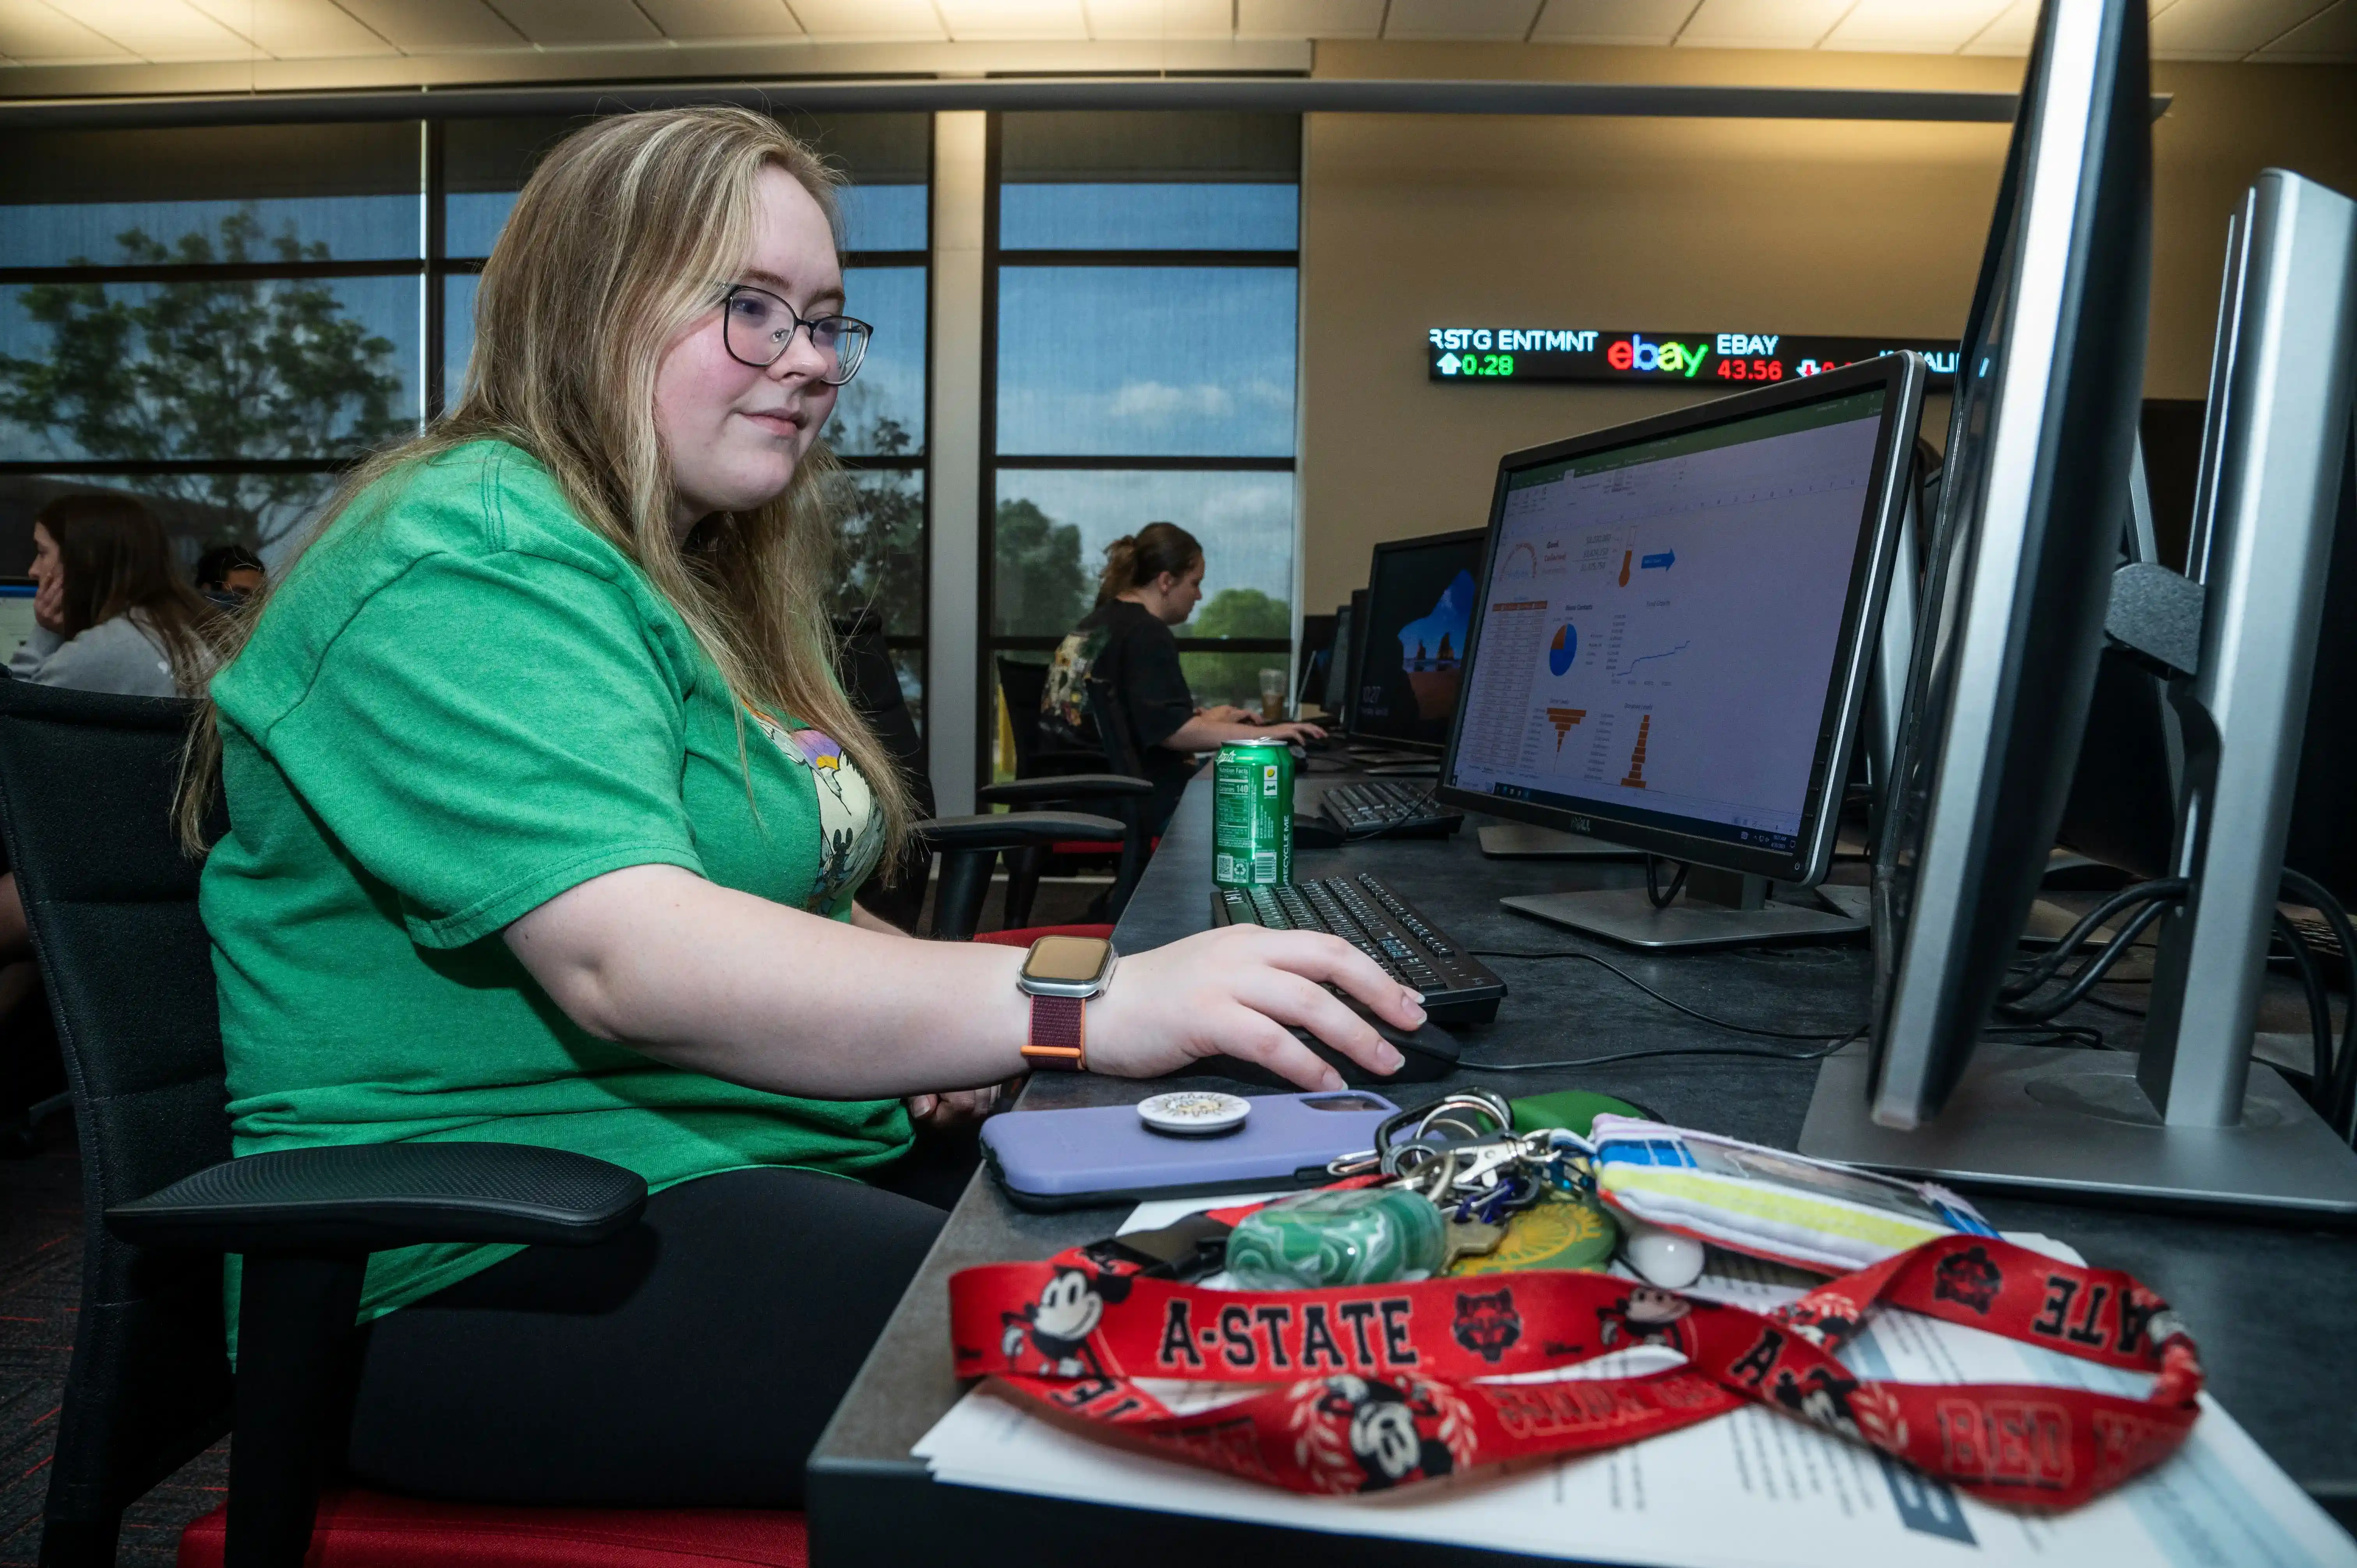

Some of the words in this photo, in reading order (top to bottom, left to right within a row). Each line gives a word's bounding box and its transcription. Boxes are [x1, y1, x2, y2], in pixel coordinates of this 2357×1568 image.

[1498, 330, 1599, 351] ENTMNT
[1717, 333, 1779, 355] EBAY
[1462, 354, 1514, 375] 0.28
[1608, 334, 1709, 377] ebay
[1717, 359, 1783, 380] 43.56
[1236, 784, 1249, 793] 140
[1284, 815, 1289, 832] ME
[1159, 1297, 1419, 1370] A-STATE
